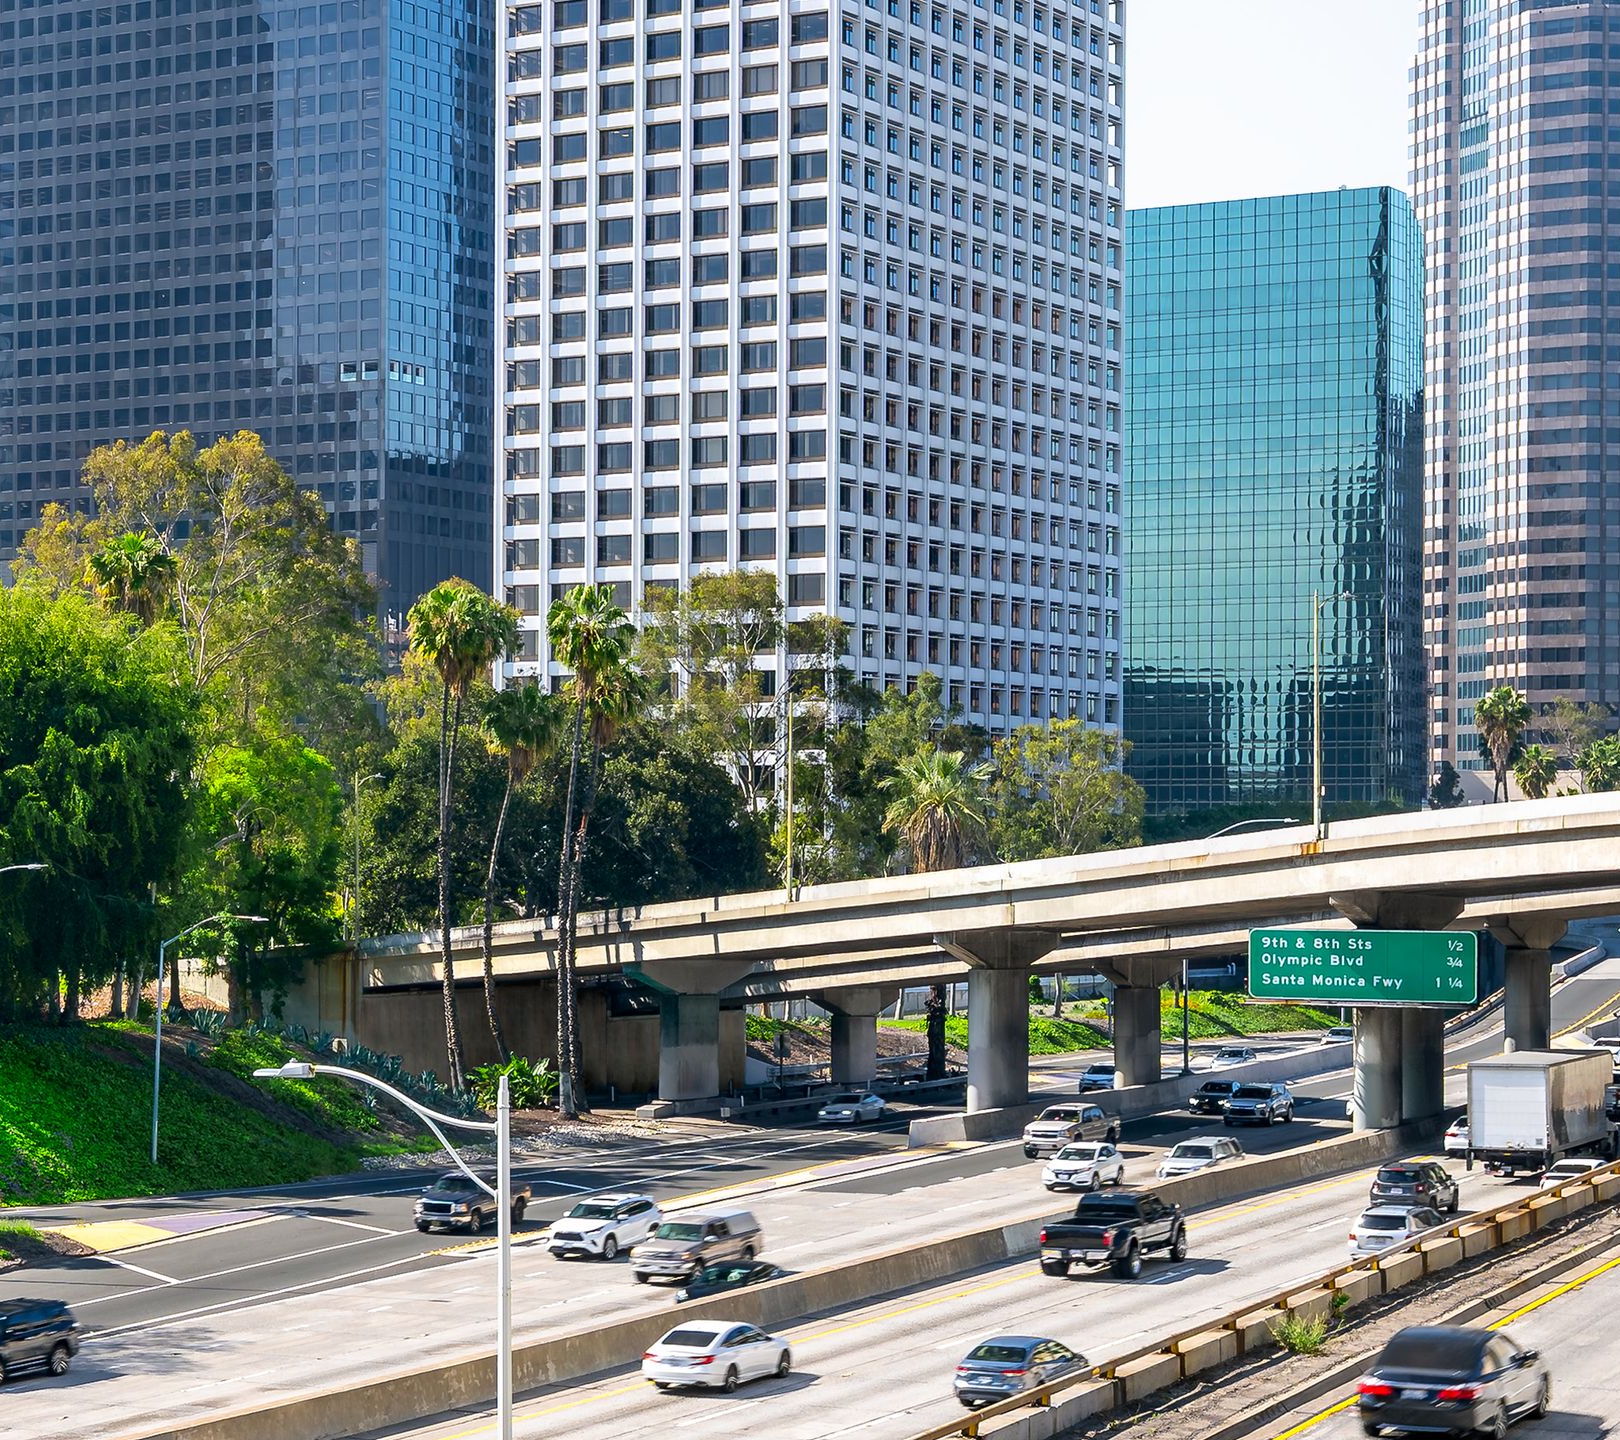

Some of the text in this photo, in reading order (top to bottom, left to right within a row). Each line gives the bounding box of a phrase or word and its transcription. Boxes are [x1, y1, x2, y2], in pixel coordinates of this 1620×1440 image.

[1261, 936, 1288, 948] 9th
[1295, 937, 1306, 949] &
[1313, 937, 1340, 949] 8th
[1348, 938, 1372, 950] Sts
[1261, 953, 1322, 967] Olympic
[1330, 954, 1364, 966] Blvd
[1261, 973, 1305, 985] Santa
[1312, 974, 1366, 987] Monica
[1373, 975, 1403, 990] Fwy
